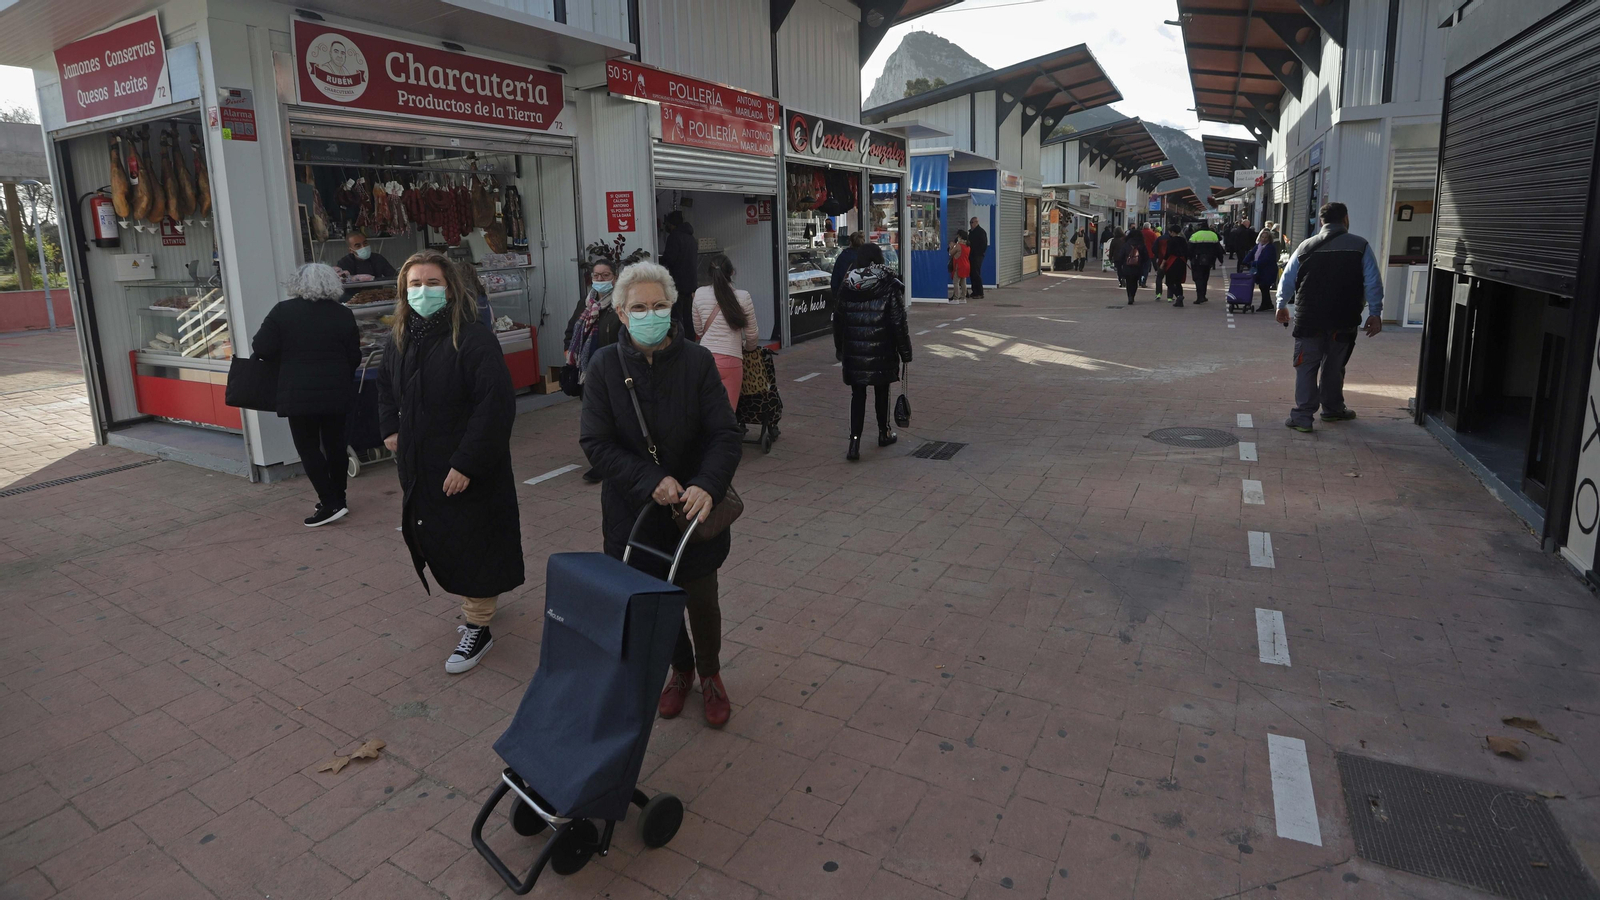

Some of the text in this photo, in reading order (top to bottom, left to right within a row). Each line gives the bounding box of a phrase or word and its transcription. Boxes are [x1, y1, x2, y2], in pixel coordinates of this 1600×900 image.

[63, 40, 156, 80] Jamones Conservas
[326, 74, 353, 85] RUBÉN
[385, 51, 549, 105] Charcutería
[608, 66, 633, 82] 50 51
[77, 75, 148, 109] Quesos Aceites
[157, 86, 166, 98] 72
[669, 81, 723, 107] POLLERÍA
[398, 90, 543, 124] Productos de la Tierra
[736, 95, 762, 109] ANTONIO
[223, 109, 253, 119] Alarma
[663, 107, 673, 120] 31
[554, 120, 564, 130] 72
[689, 120, 738, 143] POLLERÍA
[741, 128, 771, 142] ANTONIO
[810, 119, 905, 167] Castro González
[810, 294, 826, 311] hecho
